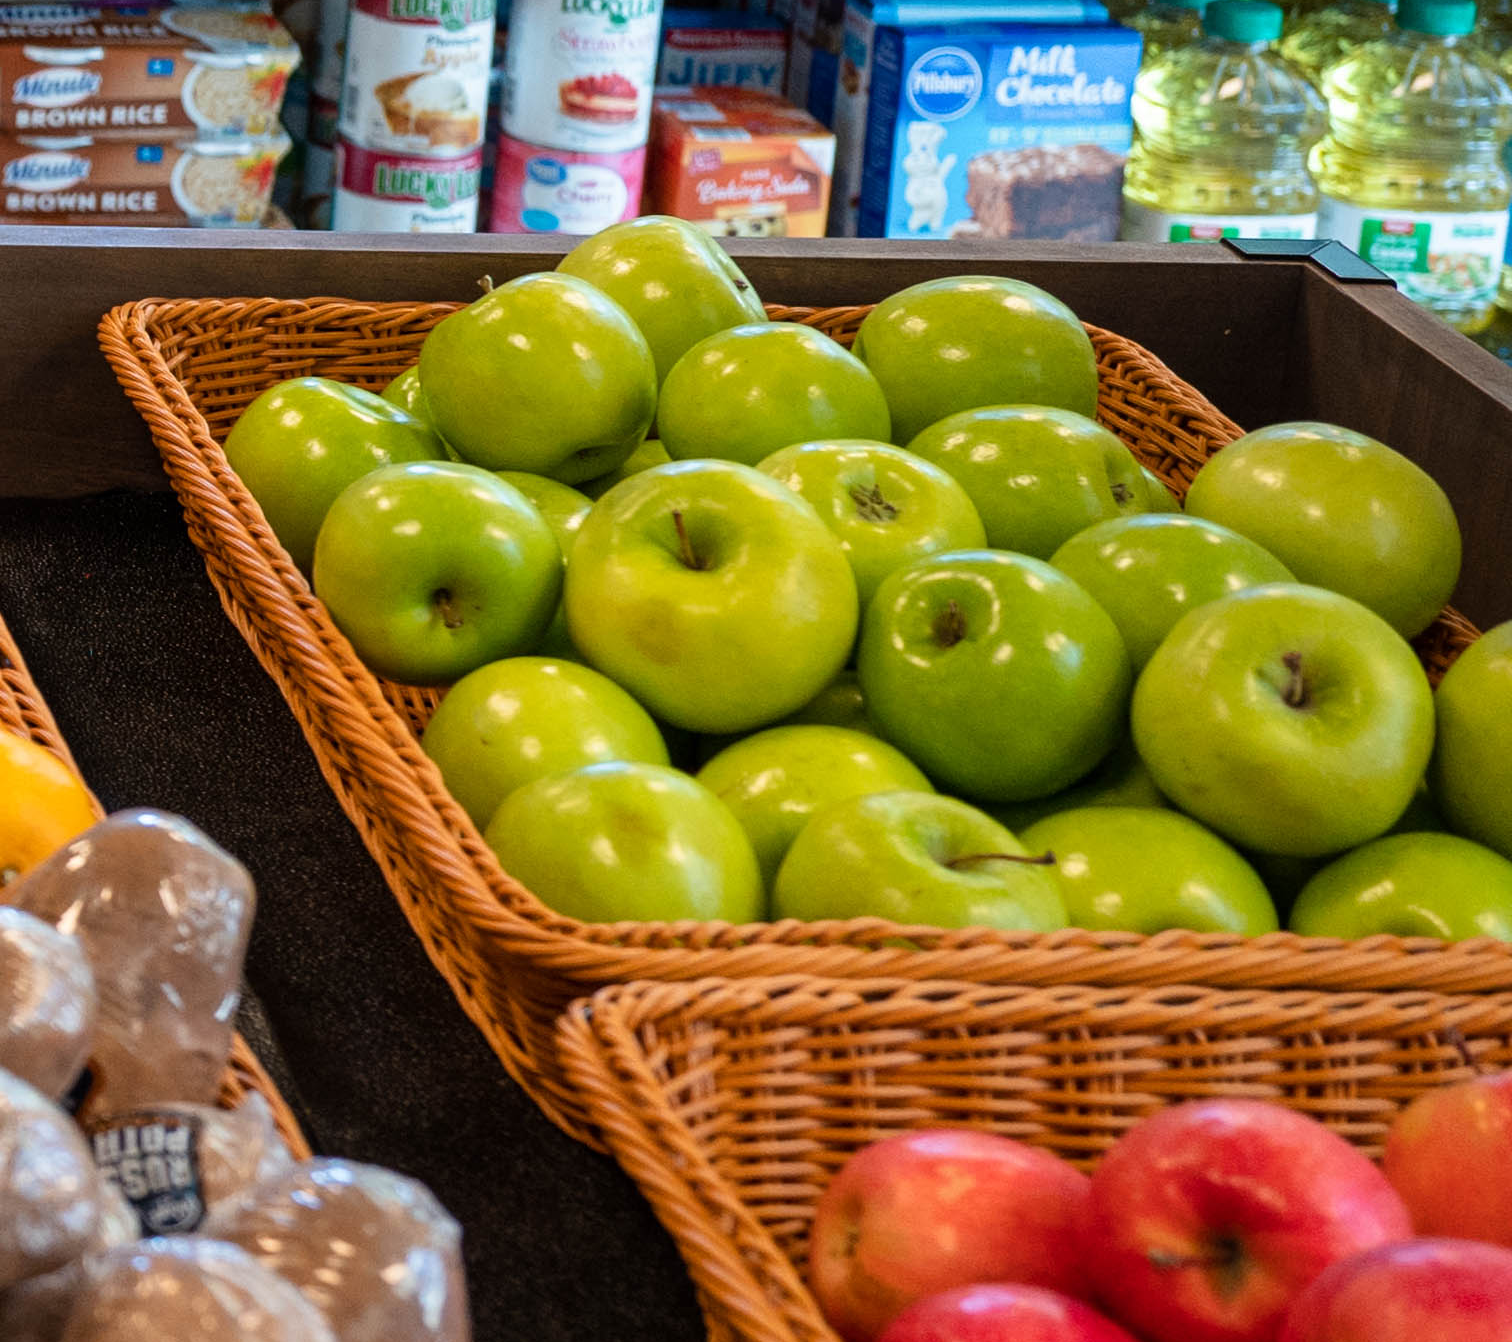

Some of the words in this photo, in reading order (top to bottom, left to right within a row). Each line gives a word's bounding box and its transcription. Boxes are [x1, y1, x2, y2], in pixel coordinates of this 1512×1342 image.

[666, 58, 776, 85] JIFFY
[1009, 45, 1076, 75] Milk
[13, 72, 102, 102] Minute
[913, 72, 976, 96] Pillsbury
[996, 76, 1126, 108] Chocolate
[16, 107, 95, 127] BROWN
[102, 106, 168, 125] RICE
